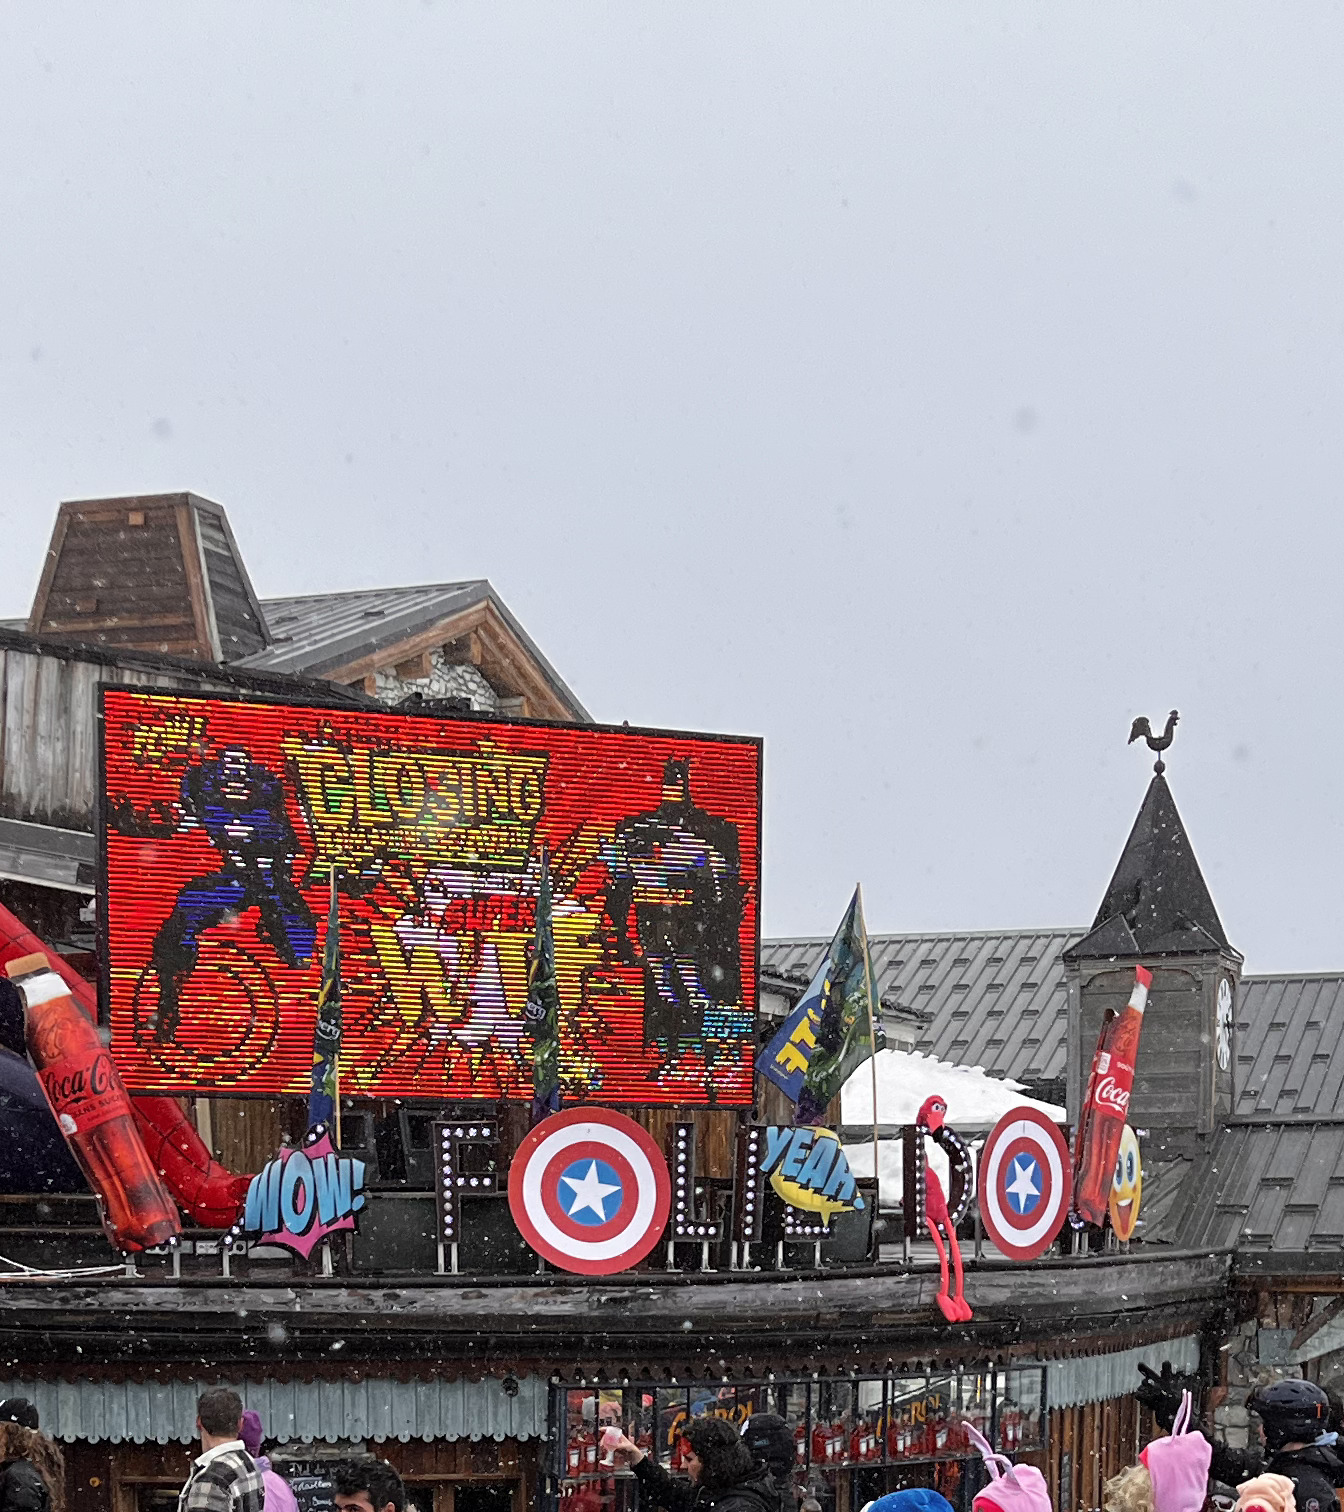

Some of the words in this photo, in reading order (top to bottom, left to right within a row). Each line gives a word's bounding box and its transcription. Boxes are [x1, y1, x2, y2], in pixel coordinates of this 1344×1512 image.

[297, 750, 544, 825] CLOSING
[445, 895, 536, 932] SUPER
[371, 912, 602, 1022] WTF
[245, 1150, 367, 1235] WOW!
